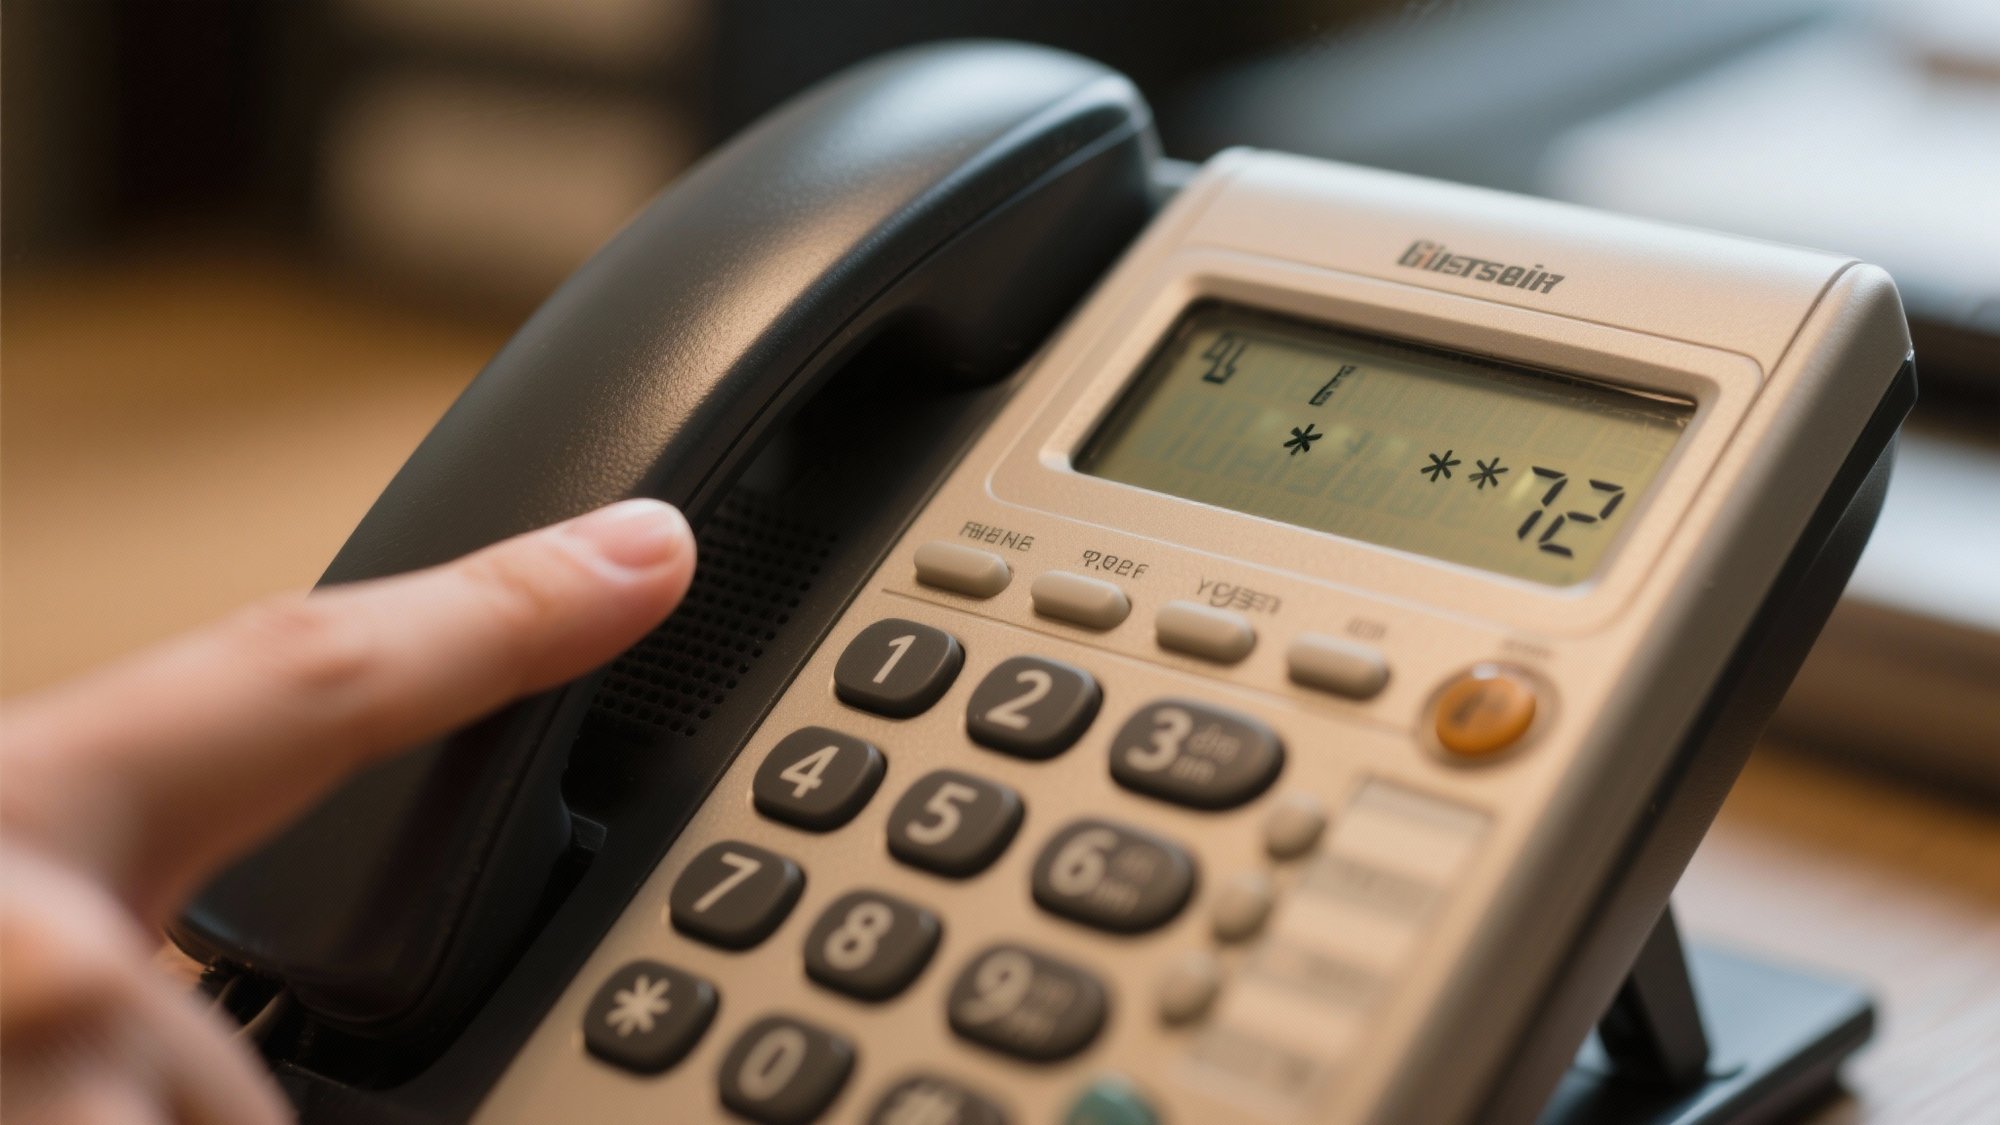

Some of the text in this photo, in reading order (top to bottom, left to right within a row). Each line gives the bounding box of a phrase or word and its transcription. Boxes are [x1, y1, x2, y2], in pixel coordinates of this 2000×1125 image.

[873, 634, 917, 684] 1
[985, 669, 1053, 730] 2
[779, 745, 840, 799] 4
[1125, 707, 1194, 773] 3
[905, 781, 979, 845] 5
[692, 851, 762, 913] 7
[1050, 828, 1119, 897] 6
[823, 901, 894, 971] 8
[958, 950, 1034, 1025] 9
[738, 1026, 807, 1099] 0
